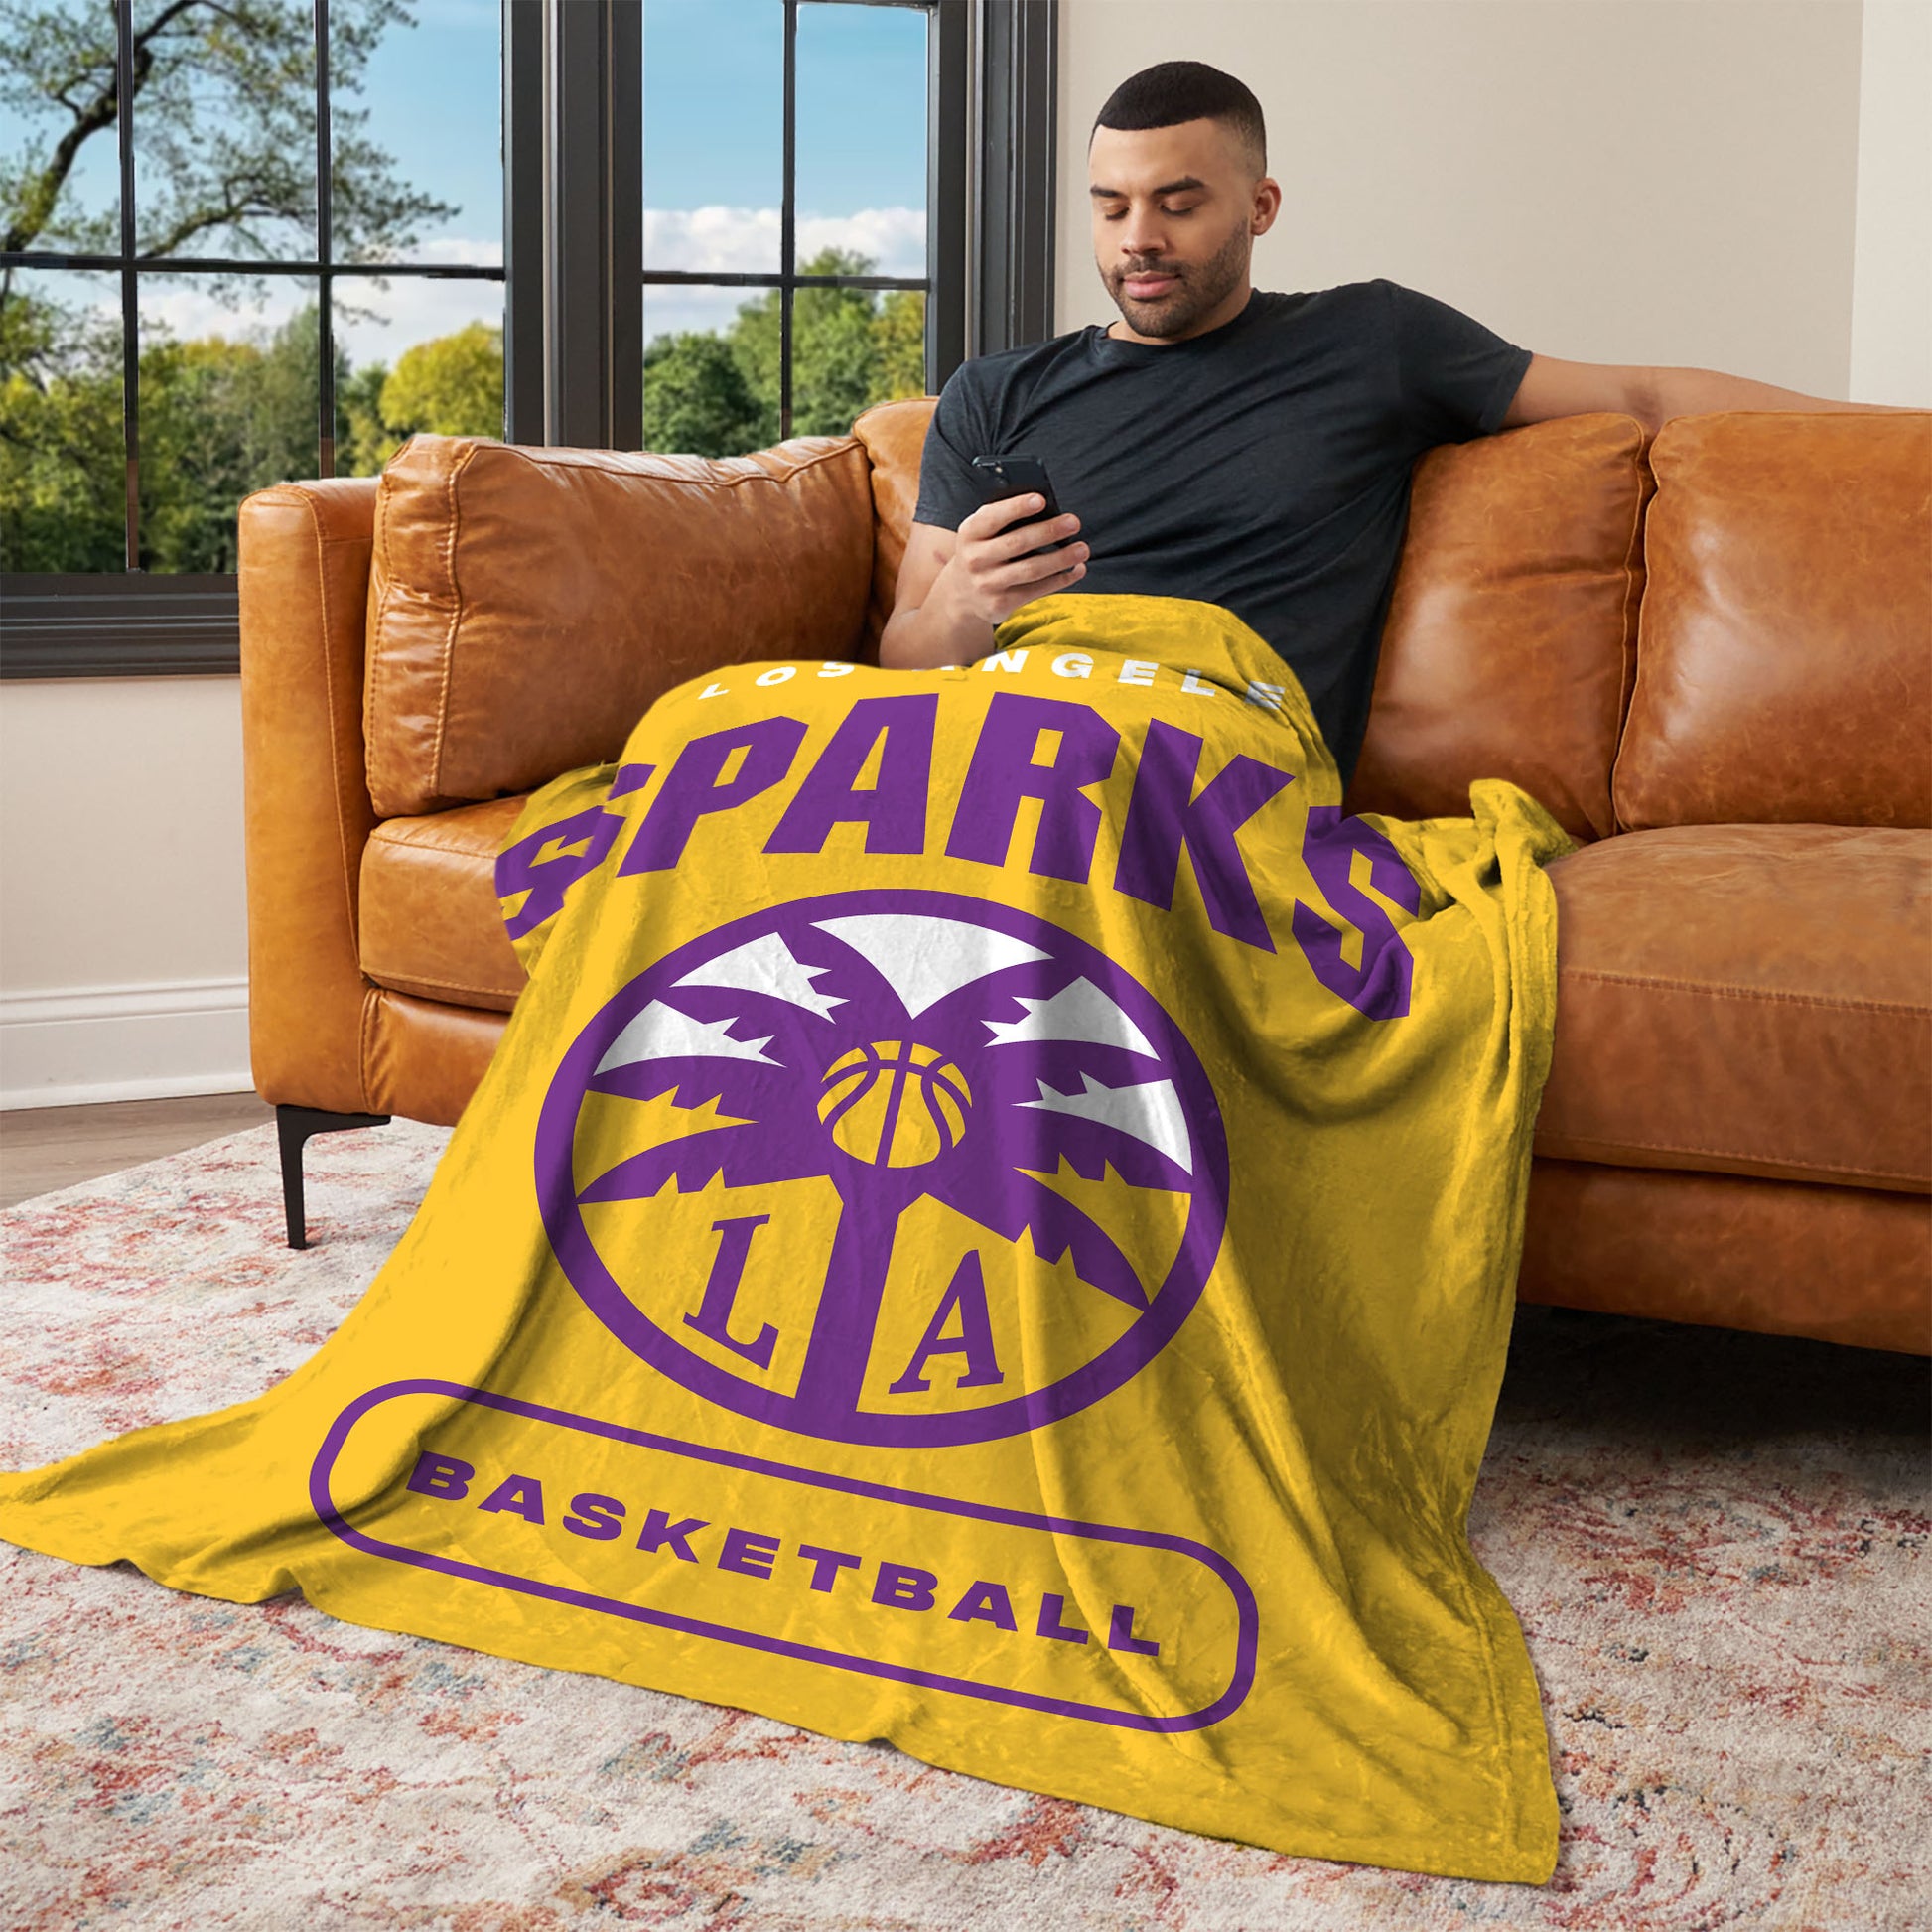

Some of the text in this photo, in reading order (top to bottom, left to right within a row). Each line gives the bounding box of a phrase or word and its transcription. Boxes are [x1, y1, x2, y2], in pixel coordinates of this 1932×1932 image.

[697, 649, 1285, 709] LOS NGELE
[494, 693, 1421, 1021] SPARKS
[405, 1450, 1160, 1657] BASKETBALL
